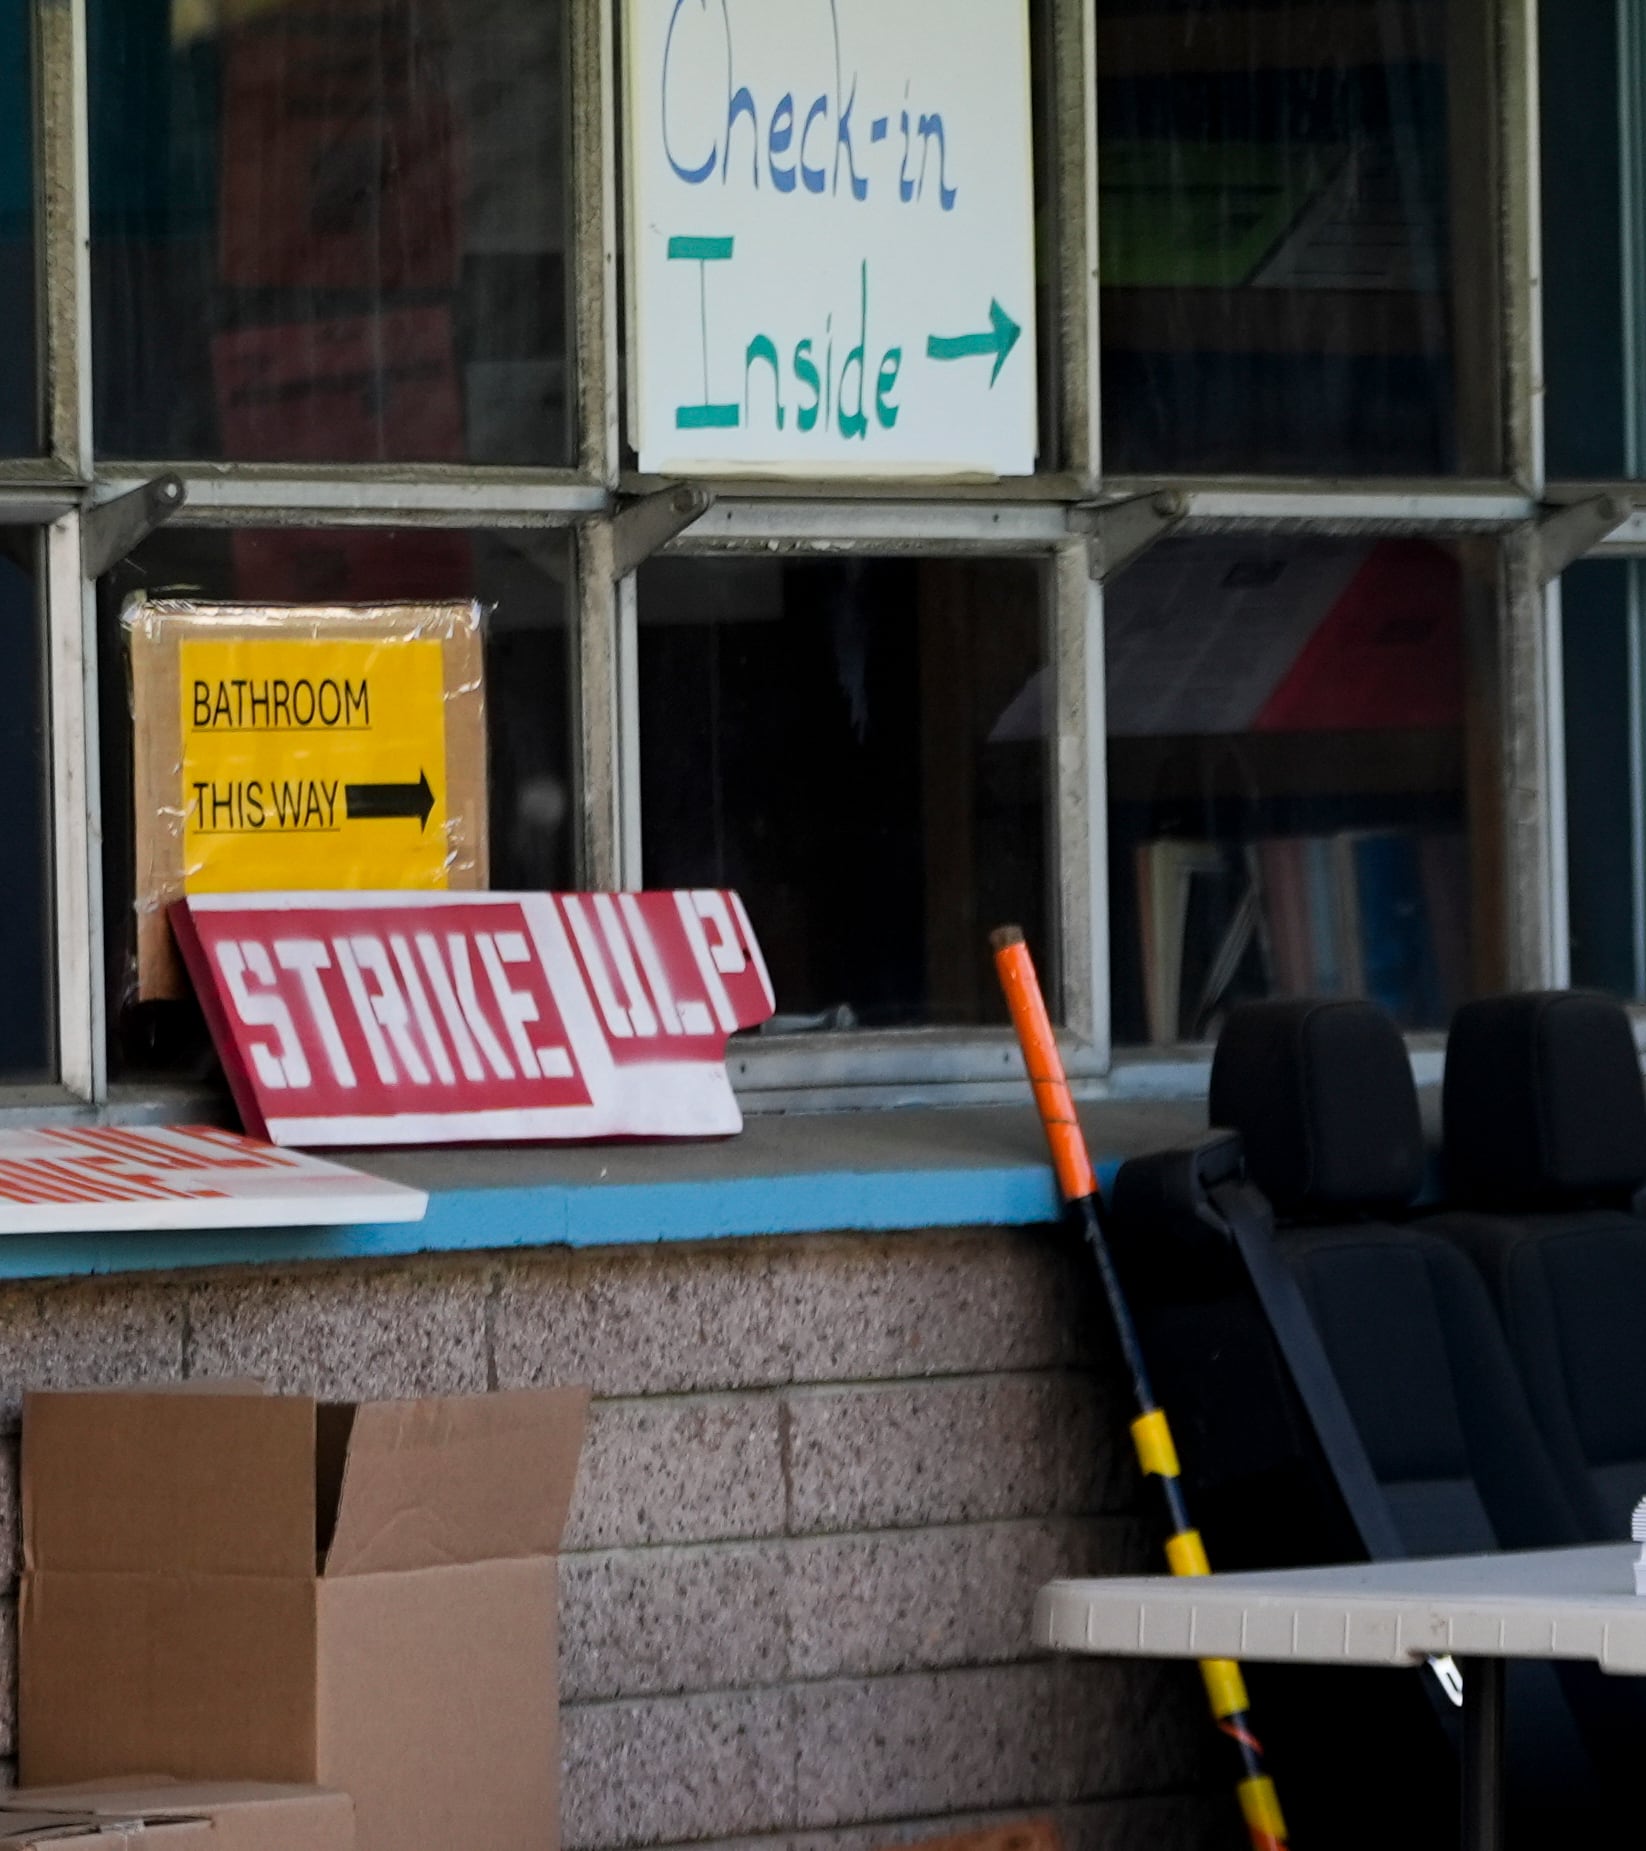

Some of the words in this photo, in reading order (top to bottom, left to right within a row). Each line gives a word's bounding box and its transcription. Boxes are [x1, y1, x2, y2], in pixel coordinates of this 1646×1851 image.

[662, 0, 958, 212] Check-in
[667, 236, 903, 440] Inside
[193, 679, 370, 727] BATHROOM
[193, 781, 266, 829] THIS
[270, 780, 339, 827] WAY
[215, 931, 575, 1088] STRIKE
[561, 889, 747, 1037] ULP
